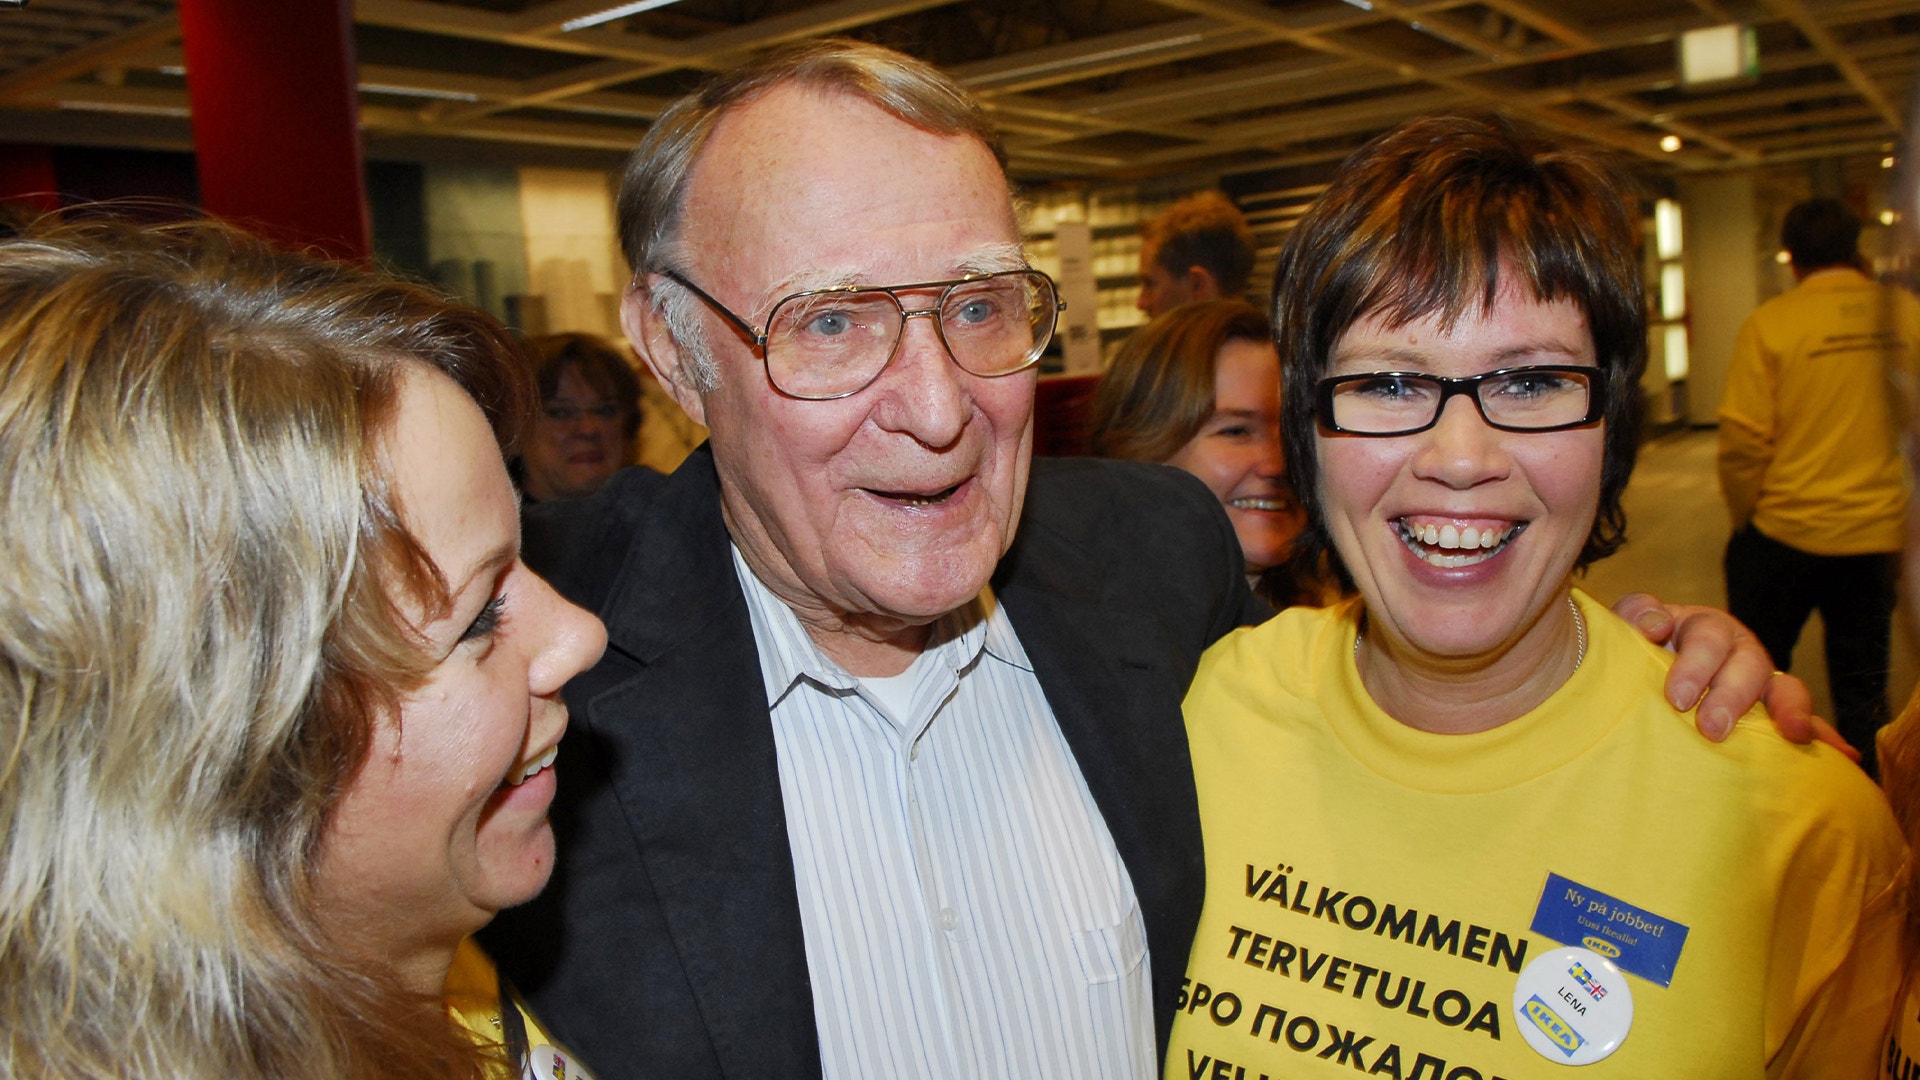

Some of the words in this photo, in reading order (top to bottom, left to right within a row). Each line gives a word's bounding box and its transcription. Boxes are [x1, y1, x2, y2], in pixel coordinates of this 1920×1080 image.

[1246, 863, 1528, 974] VÄLKOMMEN
[1564, 888, 1585, 906] Ny
[1587, 901, 1608, 916] på
[1607, 906, 1665, 938] jobbet!
[1586, 938, 1617, 956] IKEA
[1227, 925, 1501, 1041] TERVETULOA
[1557, 986, 1588, 1017] LENA
[1250, 1003, 1509, 1080] ПОЖАЛ
[1532, 1005, 1574, 1047] IKEA
